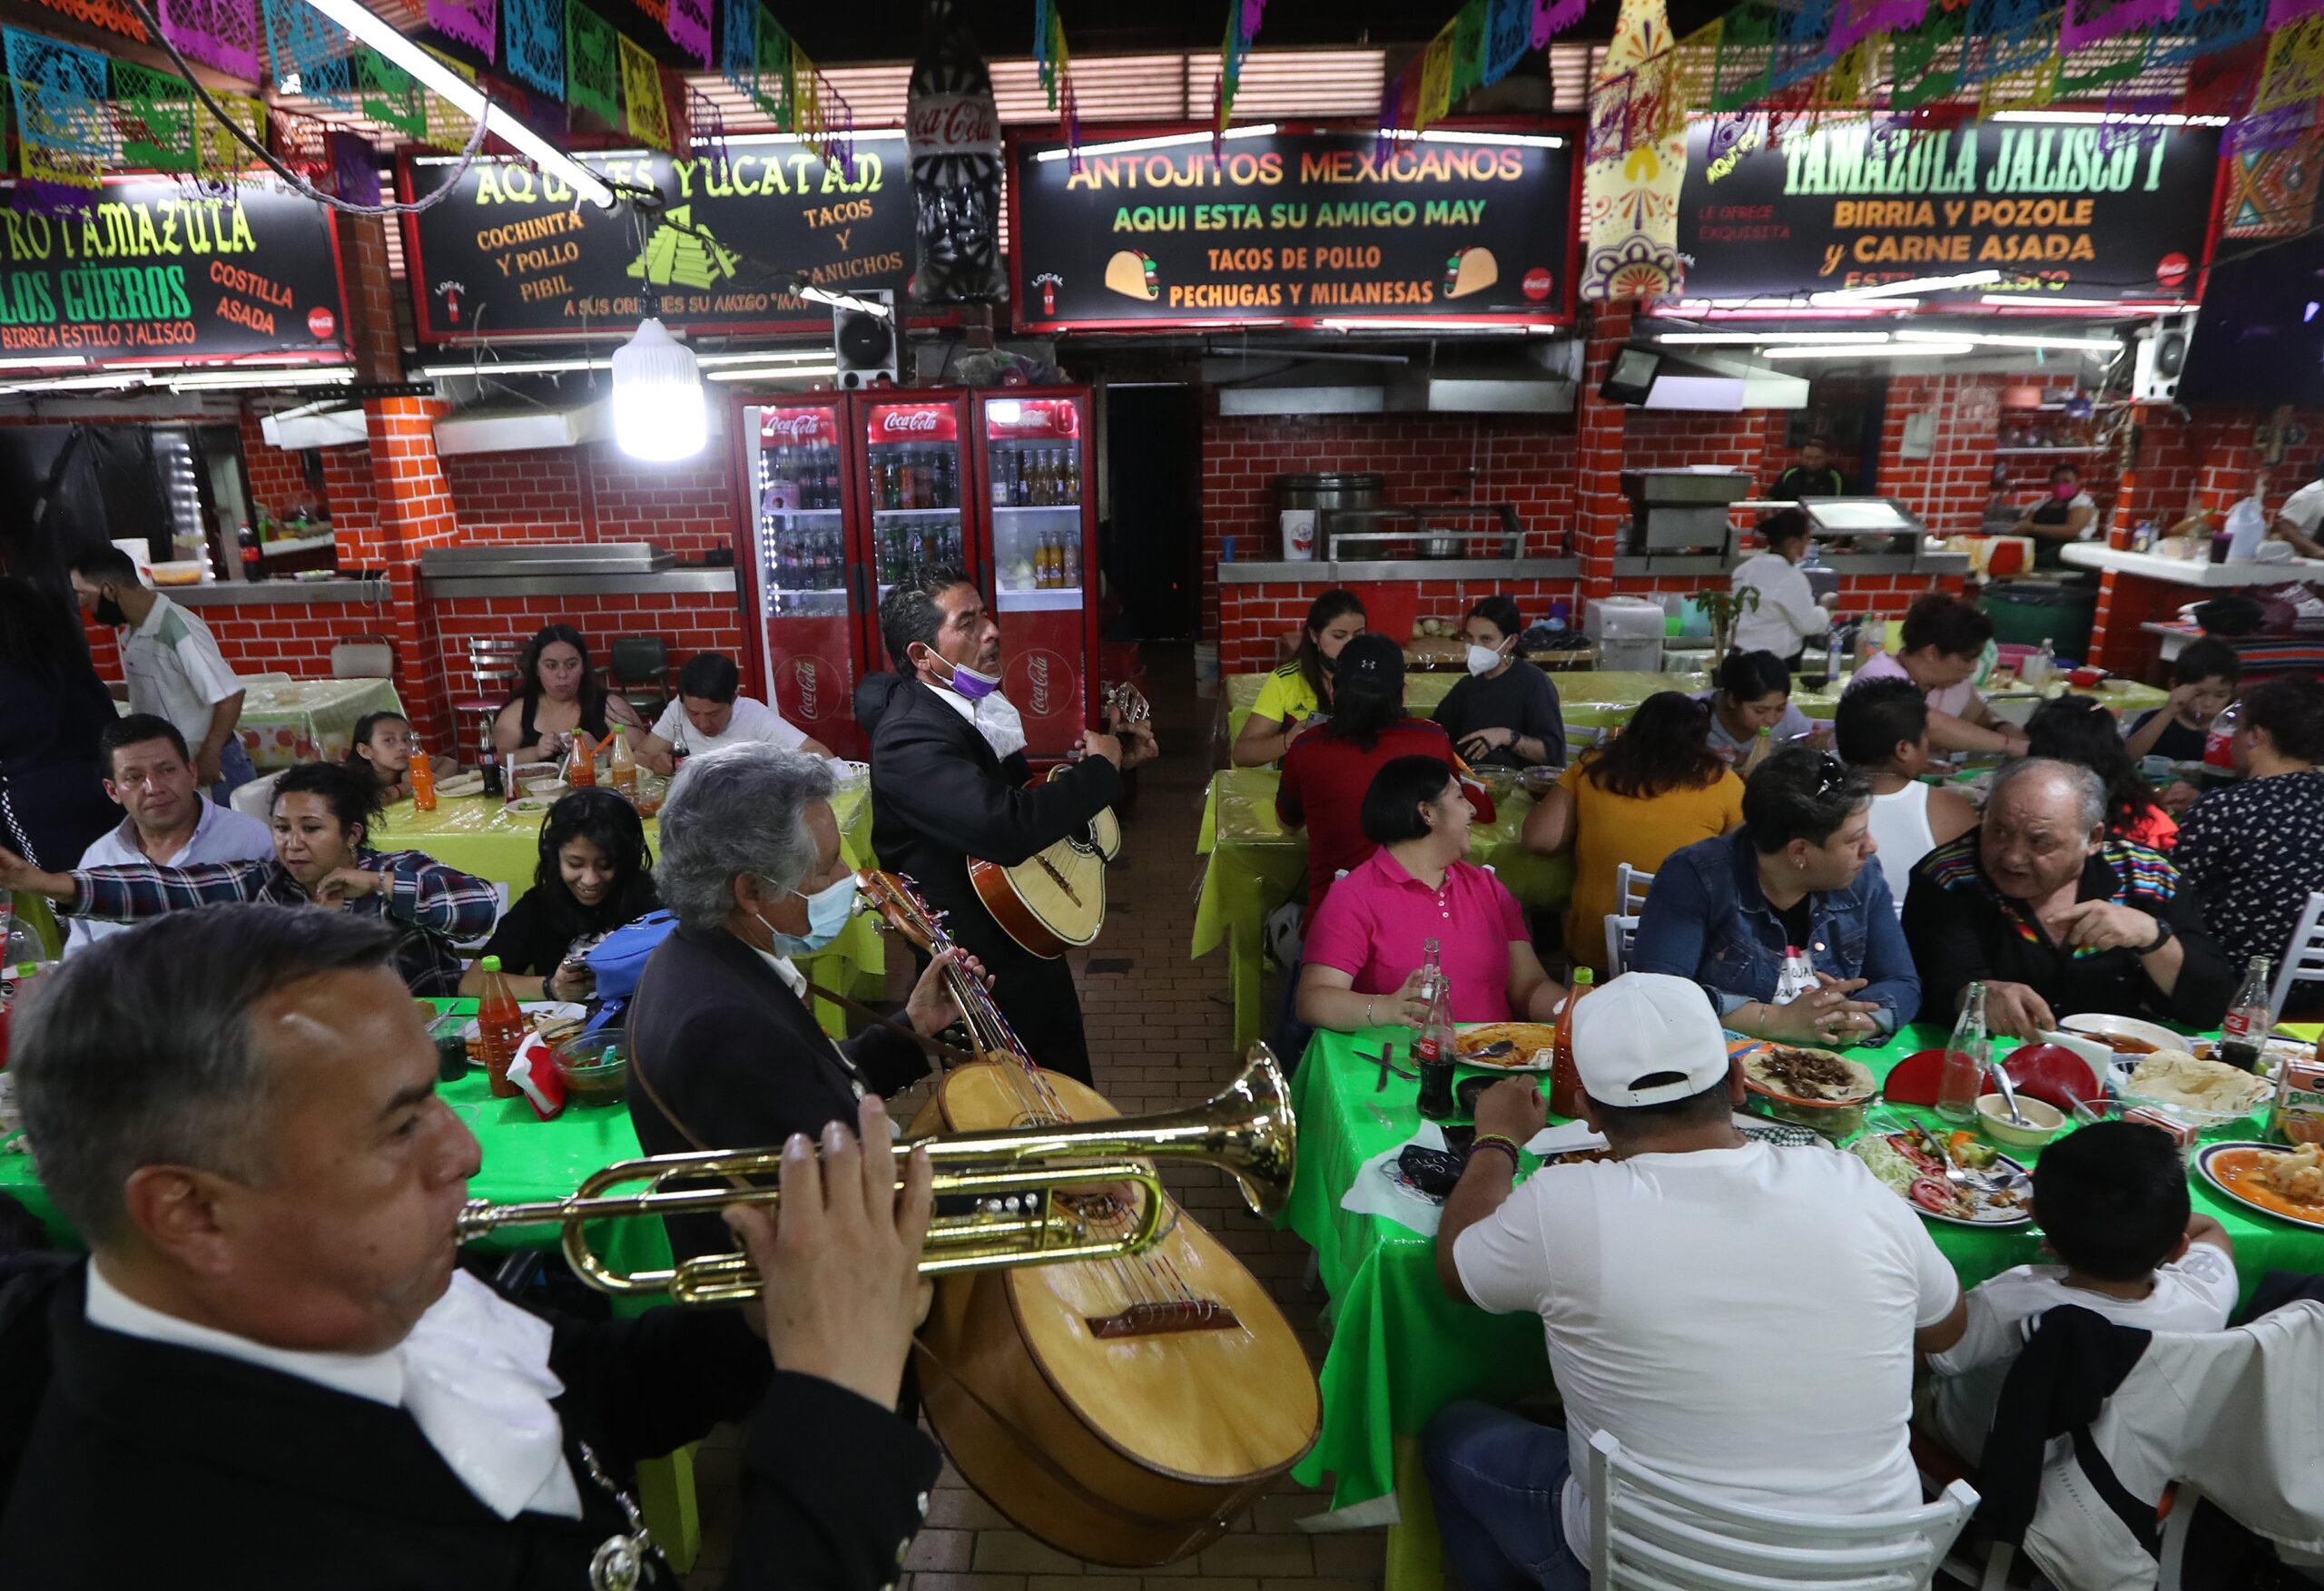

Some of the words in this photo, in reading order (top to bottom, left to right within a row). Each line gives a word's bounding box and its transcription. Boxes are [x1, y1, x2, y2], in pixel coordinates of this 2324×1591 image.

[1066, 152, 1284, 190] ANTOJITOS
[1300, 147, 1523, 183] MEXICANOS
[1782, 128, 1978, 195] TAMAZULA
[1985, 127, 2140, 193] JALISCO
[474, 162, 592, 205] AQU
[671, 152, 884, 198] YUCATAN
[803, 198, 873, 229] TACOS
[1113, 205, 1186, 232] AQUI
[1195, 203, 1263, 230] ESTA
[1271, 202, 1307, 230] SU
[1315, 200, 1416, 228] AMIGO
[1423, 199, 1487, 225] MAY
[1833, 200, 1935, 228] BIRRIA
[1944, 199, 1965, 226] Y
[1970, 198, 2095, 227] POZOLE
[0, 205, 52, 260] RO
[477, 209, 586, 252] COCHINITA
[836, 228, 852, 252] Y
[496, 252, 511, 278] Y
[516, 241, 580, 274] POLLO
[1208, 247, 1274, 271] TACOS
[1281, 247, 1307, 270] DE
[1316, 245, 1382, 270] POLLO
[1854, 234, 1972, 263] CARNE
[1977, 233, 2095, 262] ASADA
[0, 270, 57, 325] LOS
[60, 260, 192, 322] GÜEROS
[210, 260, 293, 311] COSTILLA
[520, 275, 575, 303] PIBIL
[1031, 272, 1063, 288] LOCAL
[1169, 283, 1282, 309] PECHUGAS
[1289, 282, 1304, 306] Y
[1310, 280, 1433, 306] MILANESAS
[216, 295, 275, 337] ASADA
[564, 300, 575, 316] A
[579, 298, 611, 316] SUS
[689, 297, 709, 313] SU
[714, 294, 768, 312] AMIGO
[1, 326, 58, 350] BIRRIA
[60, 323, 122, 349] ESTILO
[125, 320, 196, 347] JALISCO
